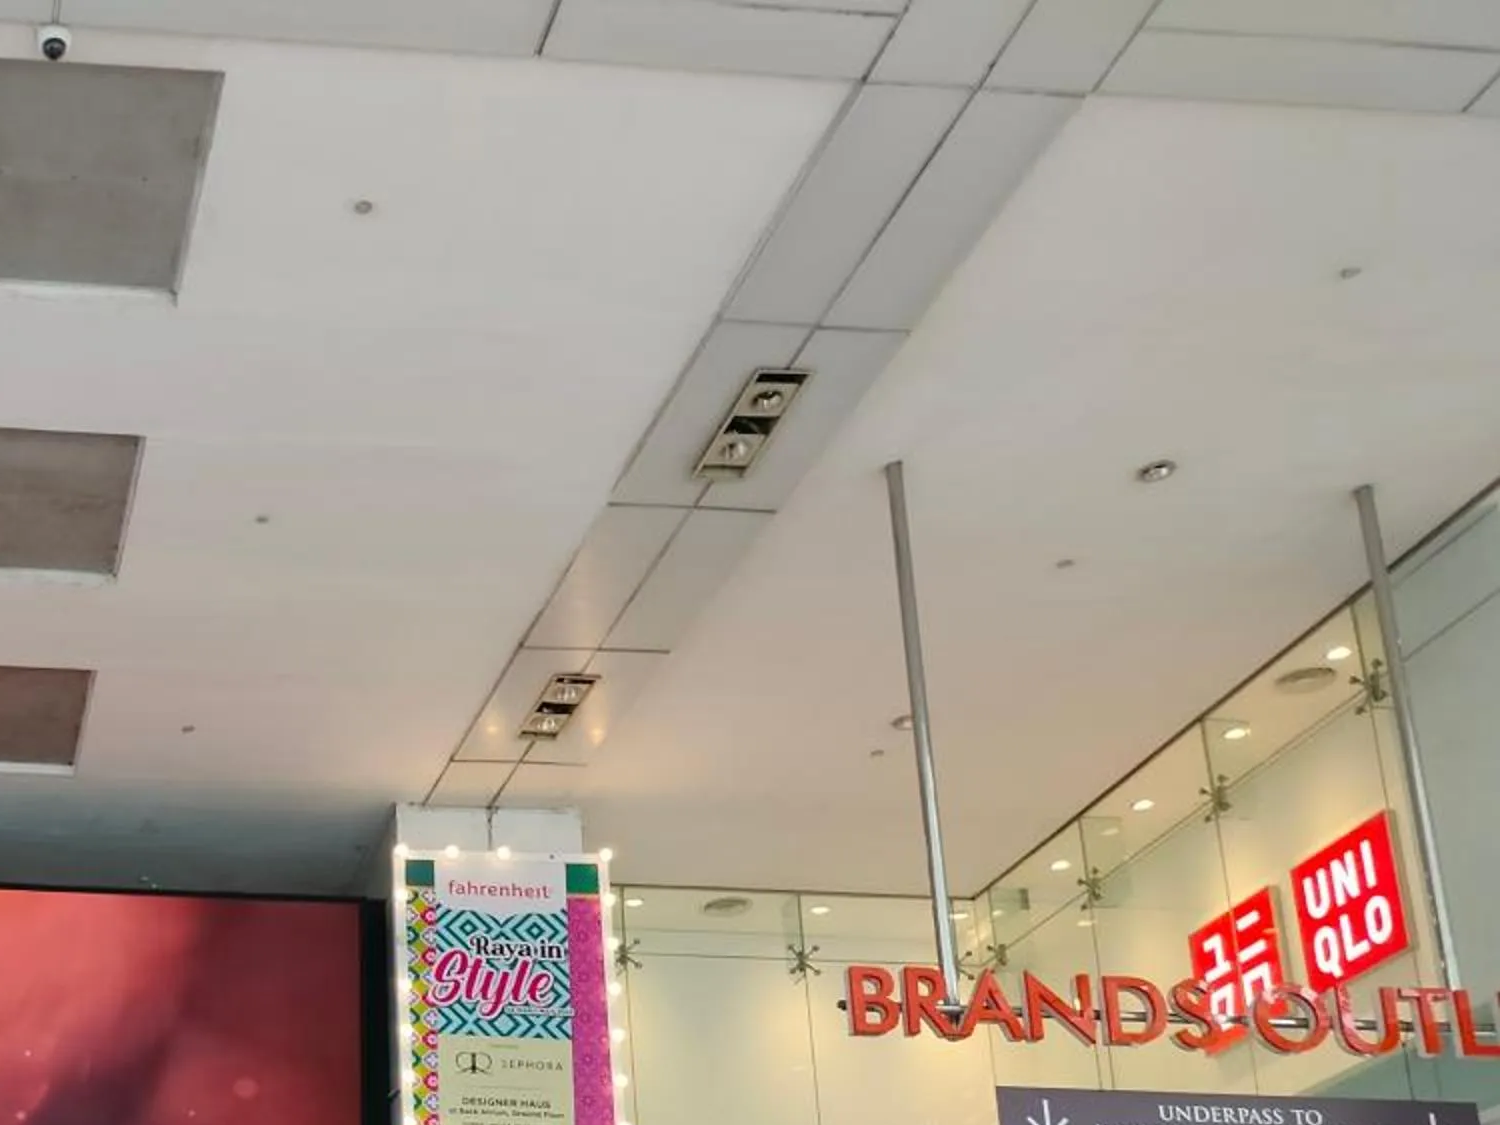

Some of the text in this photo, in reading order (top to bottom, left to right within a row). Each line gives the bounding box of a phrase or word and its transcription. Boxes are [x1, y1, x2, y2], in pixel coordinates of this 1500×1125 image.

[448, 880, 551, 900] fahrenheit
[1302, 838, 1377, 920] UNI
[469, 935, 563, 960] Raya in
[1313, 895, 1393, 978] QLO
[432, 949, 552, 1018] Style
[846, 965, 1212, 1052] BRANDS
[1158, 1105, 1285, 1125] UNDERPASS
